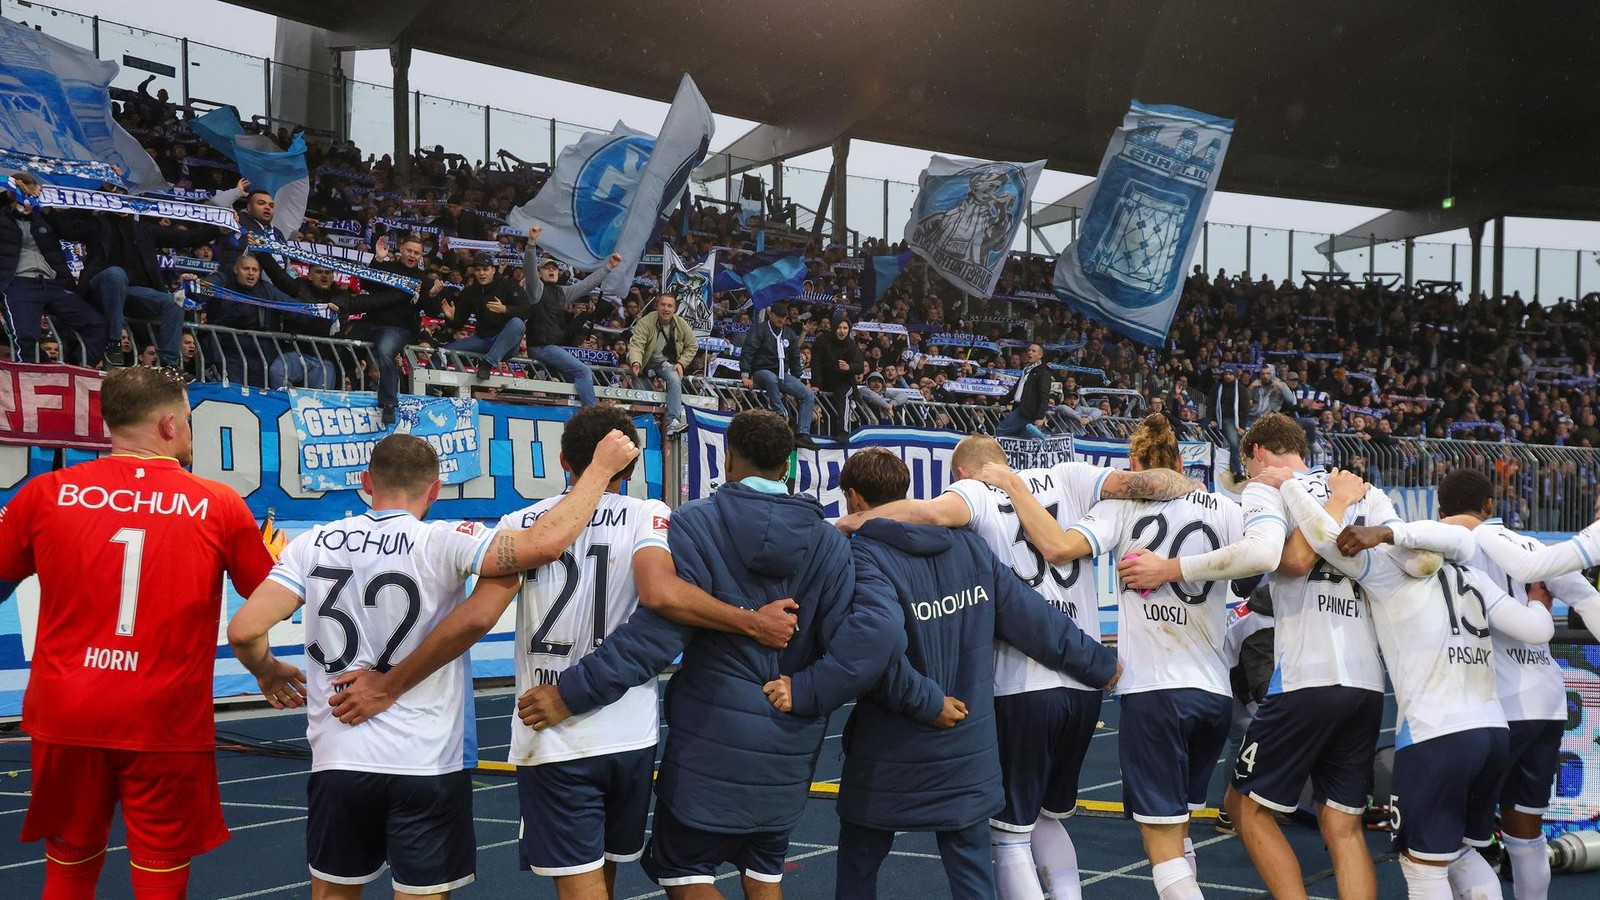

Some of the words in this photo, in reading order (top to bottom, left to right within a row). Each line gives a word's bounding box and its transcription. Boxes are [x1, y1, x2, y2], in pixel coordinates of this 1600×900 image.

[302, 406, 386, 438] GEGEN
[57, 483, 209, 520] BOCHUM
[109, 526, 147, 637] 1
[1123, 512, 1220, 605] 20
[305, 562, 423, 675] 32
[526, 544, 612, 658] 21
[1143, 603, 1188, 626] LOOSLI
[1437, 561, 1491, 639] 15
[83, 646, 139, 672] HORN
